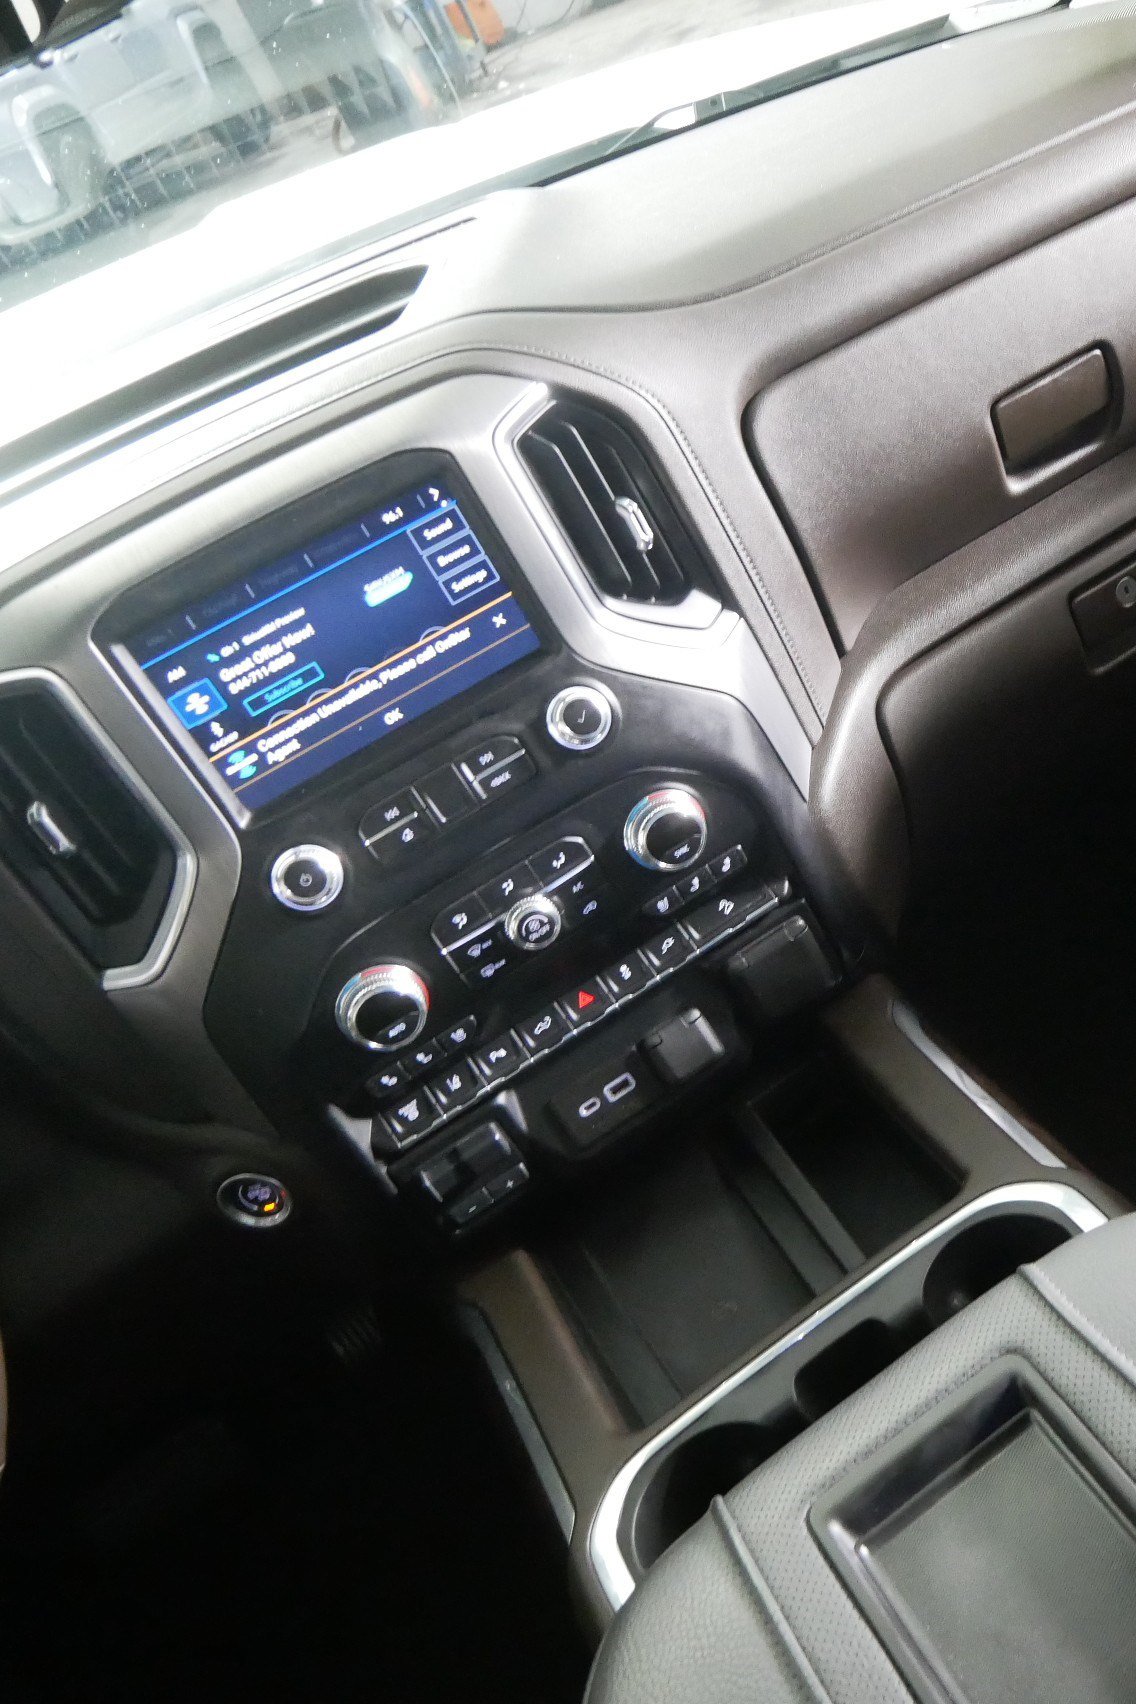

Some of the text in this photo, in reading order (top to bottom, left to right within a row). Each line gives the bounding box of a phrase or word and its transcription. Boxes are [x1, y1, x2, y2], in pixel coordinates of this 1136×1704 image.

[423, 518, 453, 540] Sound
[437, 544, 471, 567] Browse
[451, 569, 488, 593] Settings
[220, 657, 255, 682] Great
[252, 641, 283, 664] Offer
[257, 712, 320, 752] Connection
[379, 658, 417, 684] Please
[416, 645, 437, 665] call
[384, 707, 404, 725] OK
[266, 738, 301, 765] Agent
